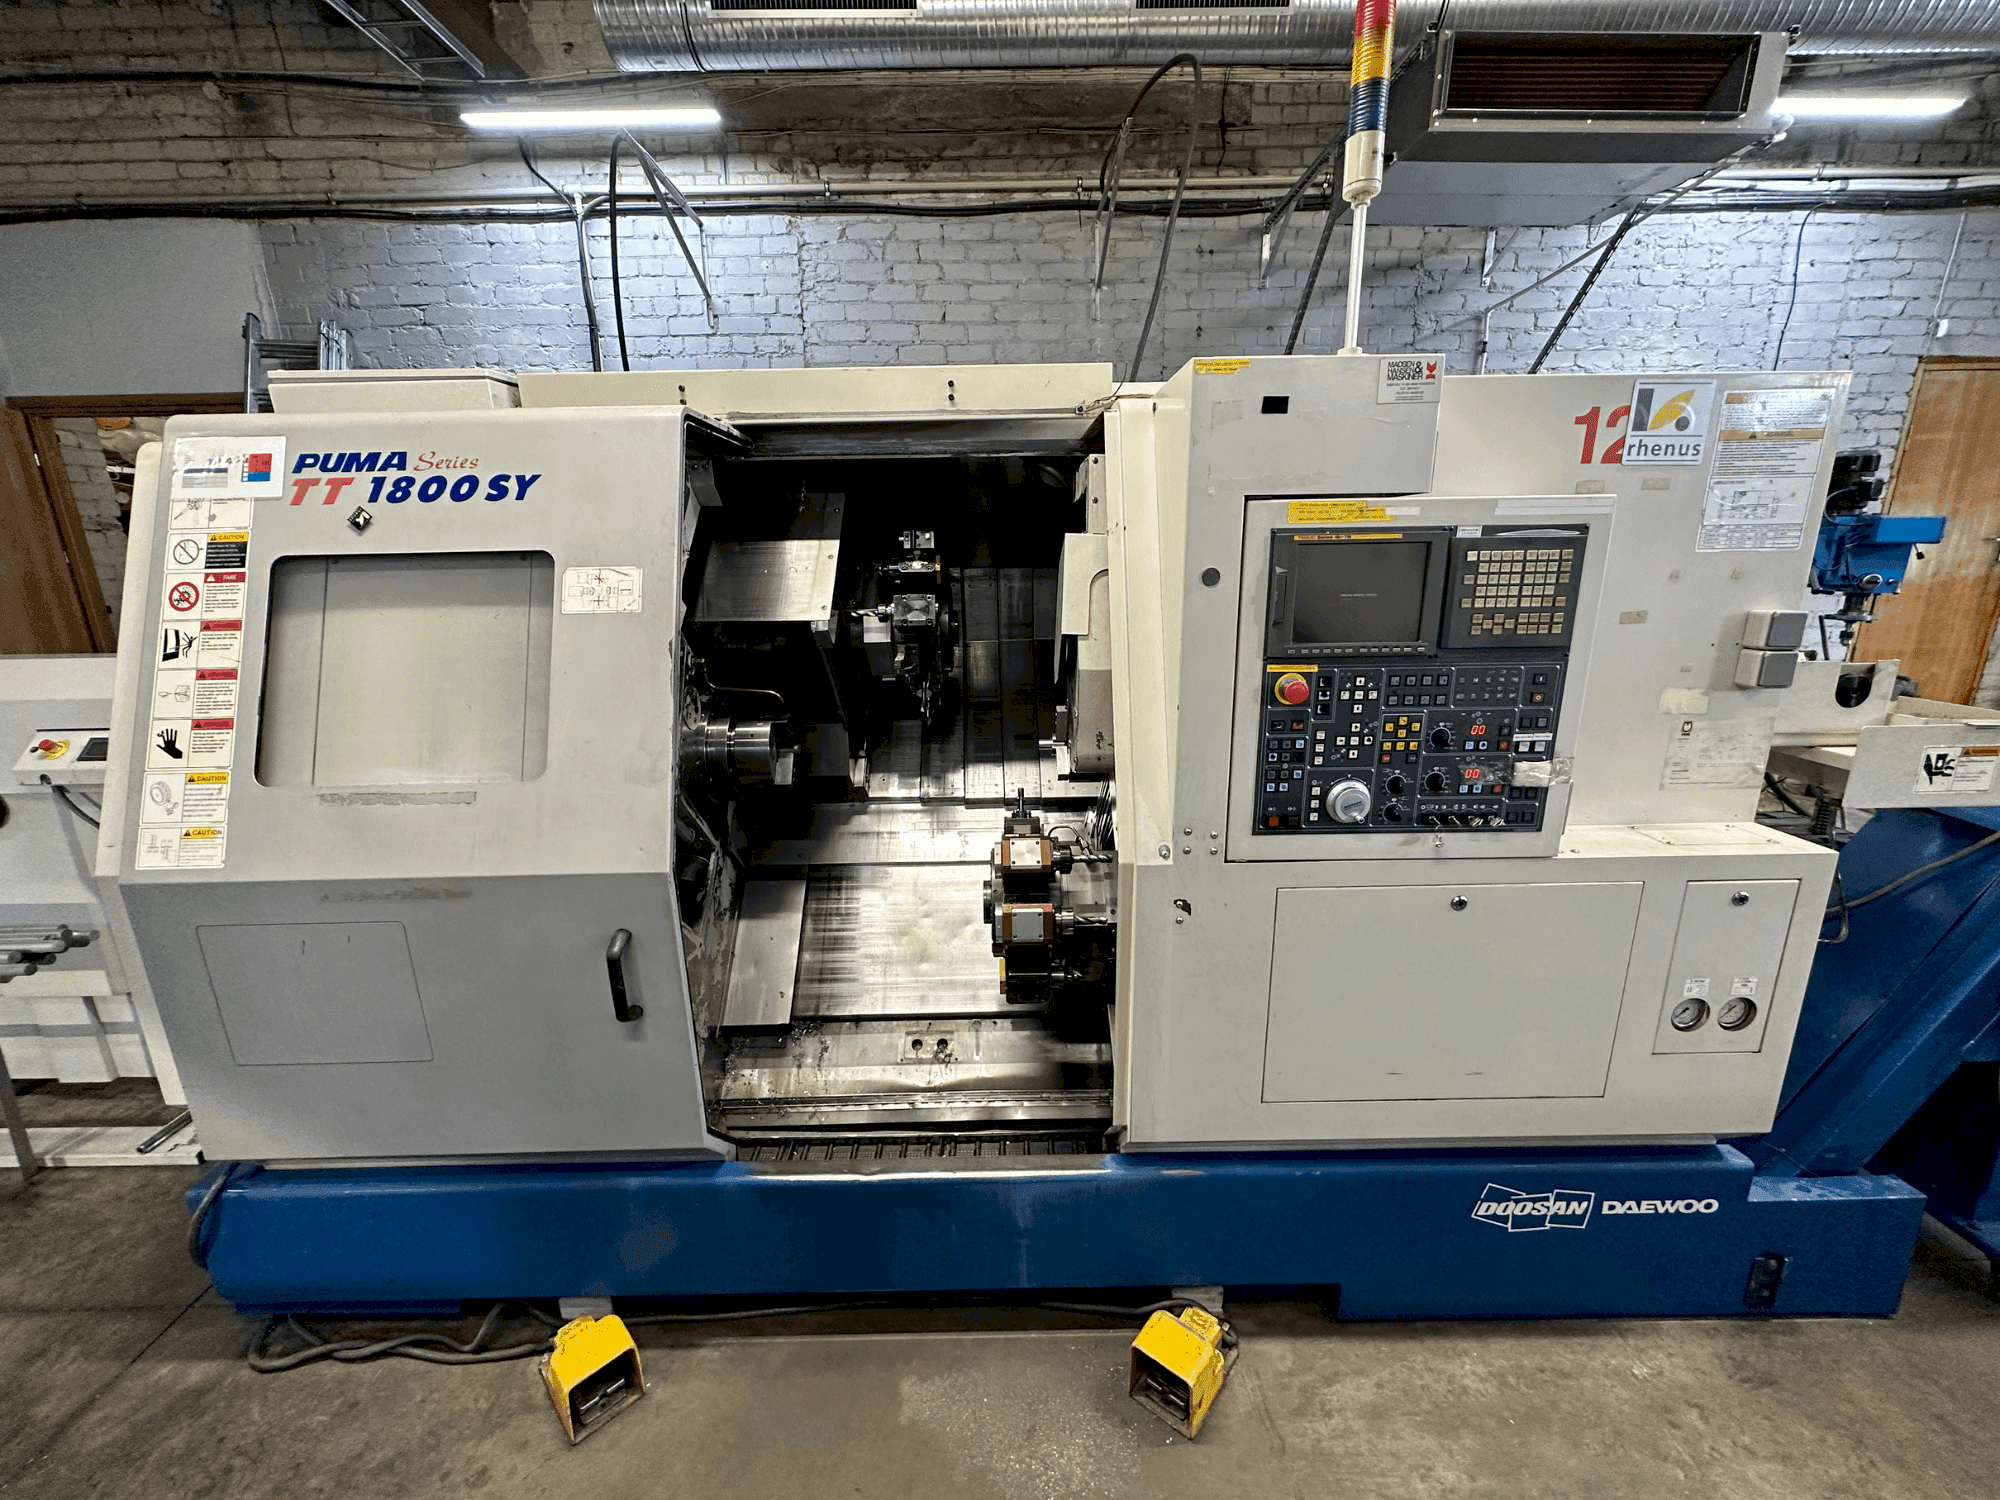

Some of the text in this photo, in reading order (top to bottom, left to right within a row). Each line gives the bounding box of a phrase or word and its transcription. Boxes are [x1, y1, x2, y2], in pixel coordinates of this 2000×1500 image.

[1415, 361, 1423, 373] &
[1387, 372, 1423, 380] MASKINER
[1574, 405, 1630, 464] 12
[1627, 439, 1701, 456] rhenus
[292, 451, 479, 473] PUMA Series
[289, 474, 542, 506] TT 1800SY
[1470, 725, 1486, 735] 00
[1477, 1199, 1719, 1215] DOOSAN DAEWOO
